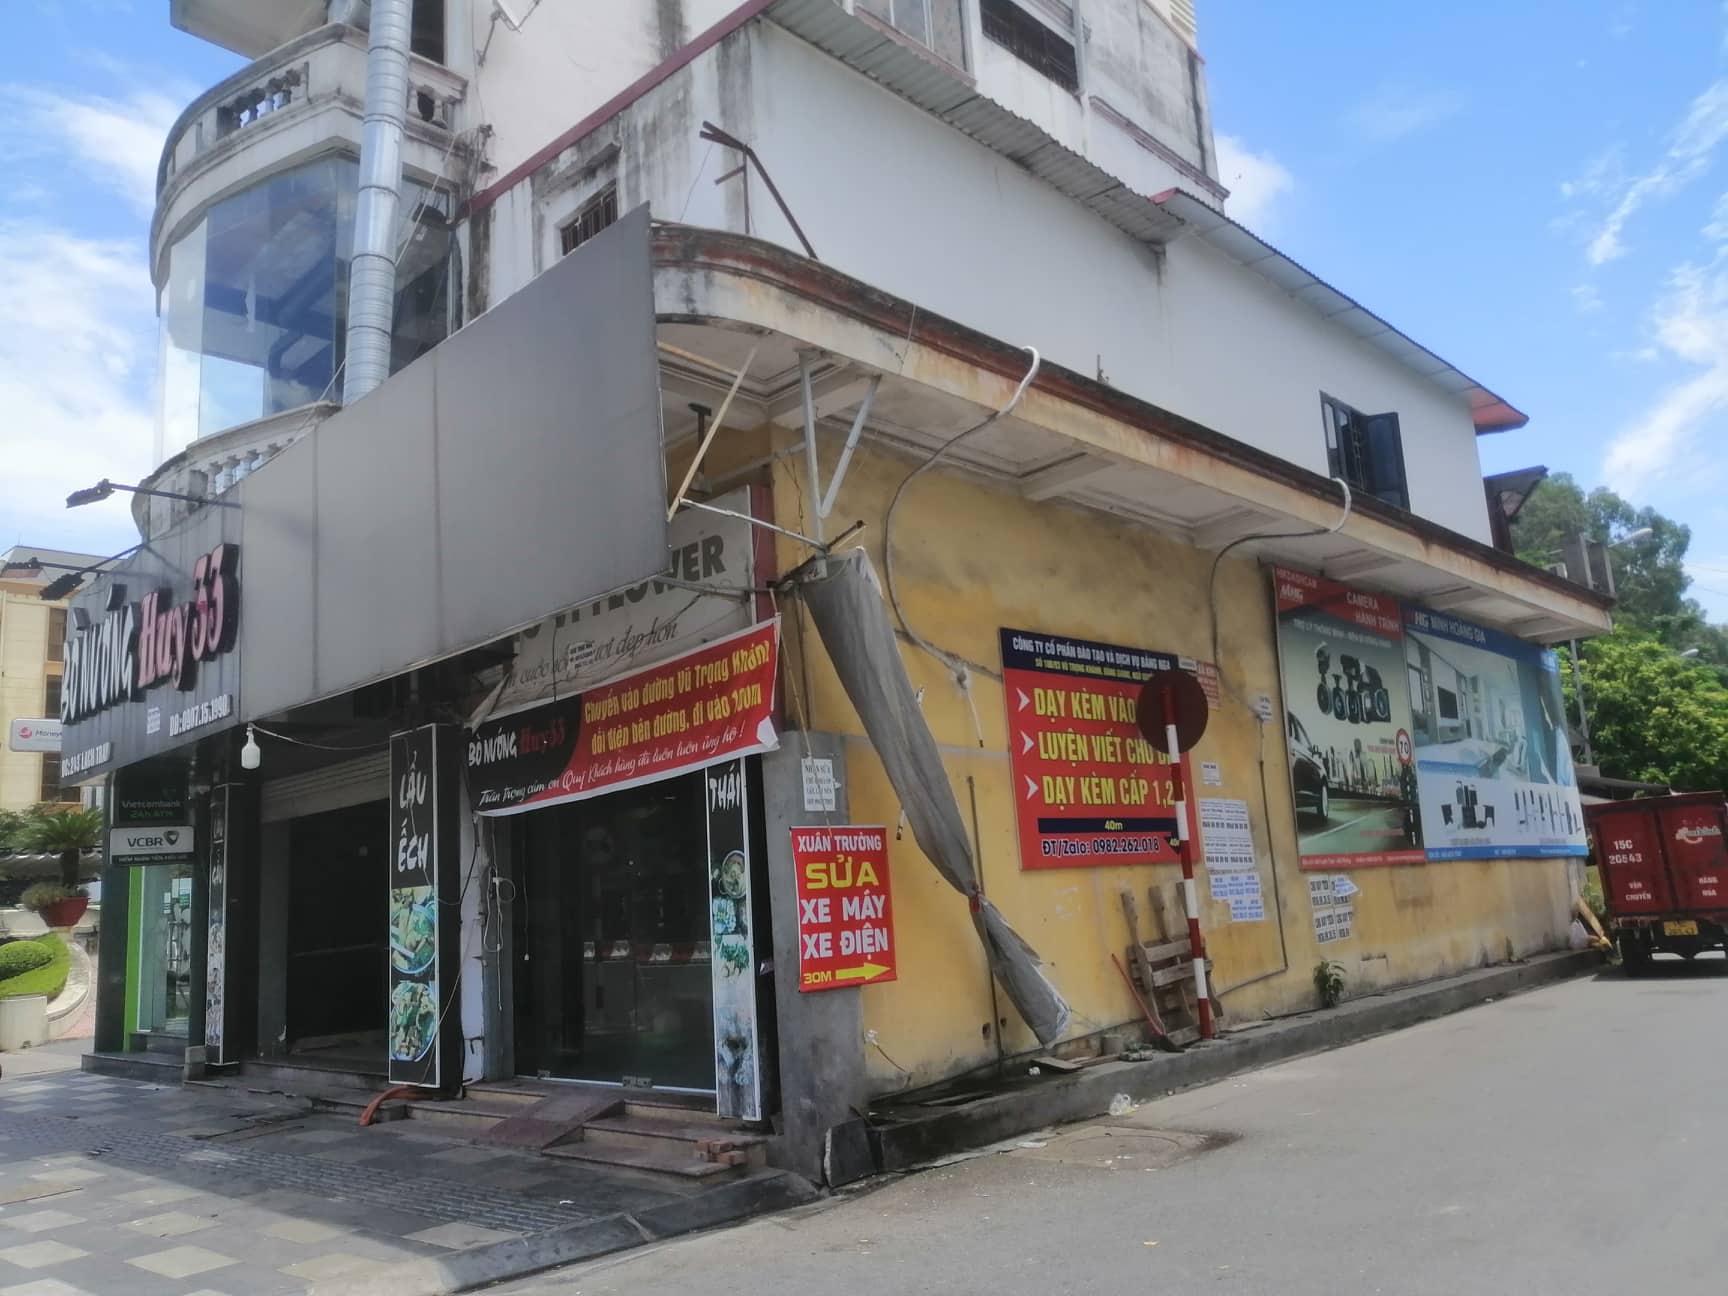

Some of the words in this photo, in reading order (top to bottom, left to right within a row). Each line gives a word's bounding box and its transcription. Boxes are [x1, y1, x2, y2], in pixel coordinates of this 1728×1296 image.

[1346, 591, 1380, 611] CAMERA
[1012, 635, 1034, 652] CÔNG
[1034, 640, 1044, 654] TY
[642, 676, 674, 706] đường
[676, 666, 692, 694] Vũ
[694, 657, 730, 689] Trọng
[632, 717, 650, 744] bên
[692, 700, 704, 727] đi
[706, 693, 730, 722] vào
[1034, 687, 1066, 724] DẠY
[1071, 687, 1106, 721] KÈM
[1108, 692, 1136, 724] VÀO
[468, 733, 482, 767] BÒ
[484, 727, 518, 764] NƯỚNG
[1038, 727, 1089, 768] LUYỆN
[1092, 727, 1122, 764] VIẾT
[588, 759, 612, 784] Khách
[614, 755, 636, 776] hàng
[708, 763, 741, 812] THÁI
[1042, 775, 1075, 811] DẠY
[1080, 770, 1116, 805] KÈM
[1119, 769, 1149, 805] CẤP
[127, 837, 164, 848] VCBR
[798, 831, 832, 853] XUÂN
[834, 831, 882, 852] TRƯỜNG
[1104, 820, 1124, 831] 40m
[398, 817, 428, 872] ẾCH
[1042, 838, 1090, 858] ĐT/Zalo:
[1613, 839, 1633, 850] 15C
[806, 854, 879, 890] SỬA
[800, 898, 832, 925] XE
[842, 889, 886, 922] MÁY
[803, 932, 833, 960] XE
[840, 922, 888, 961] ĐIỆN
[804, 970, 832, 984] 30M
